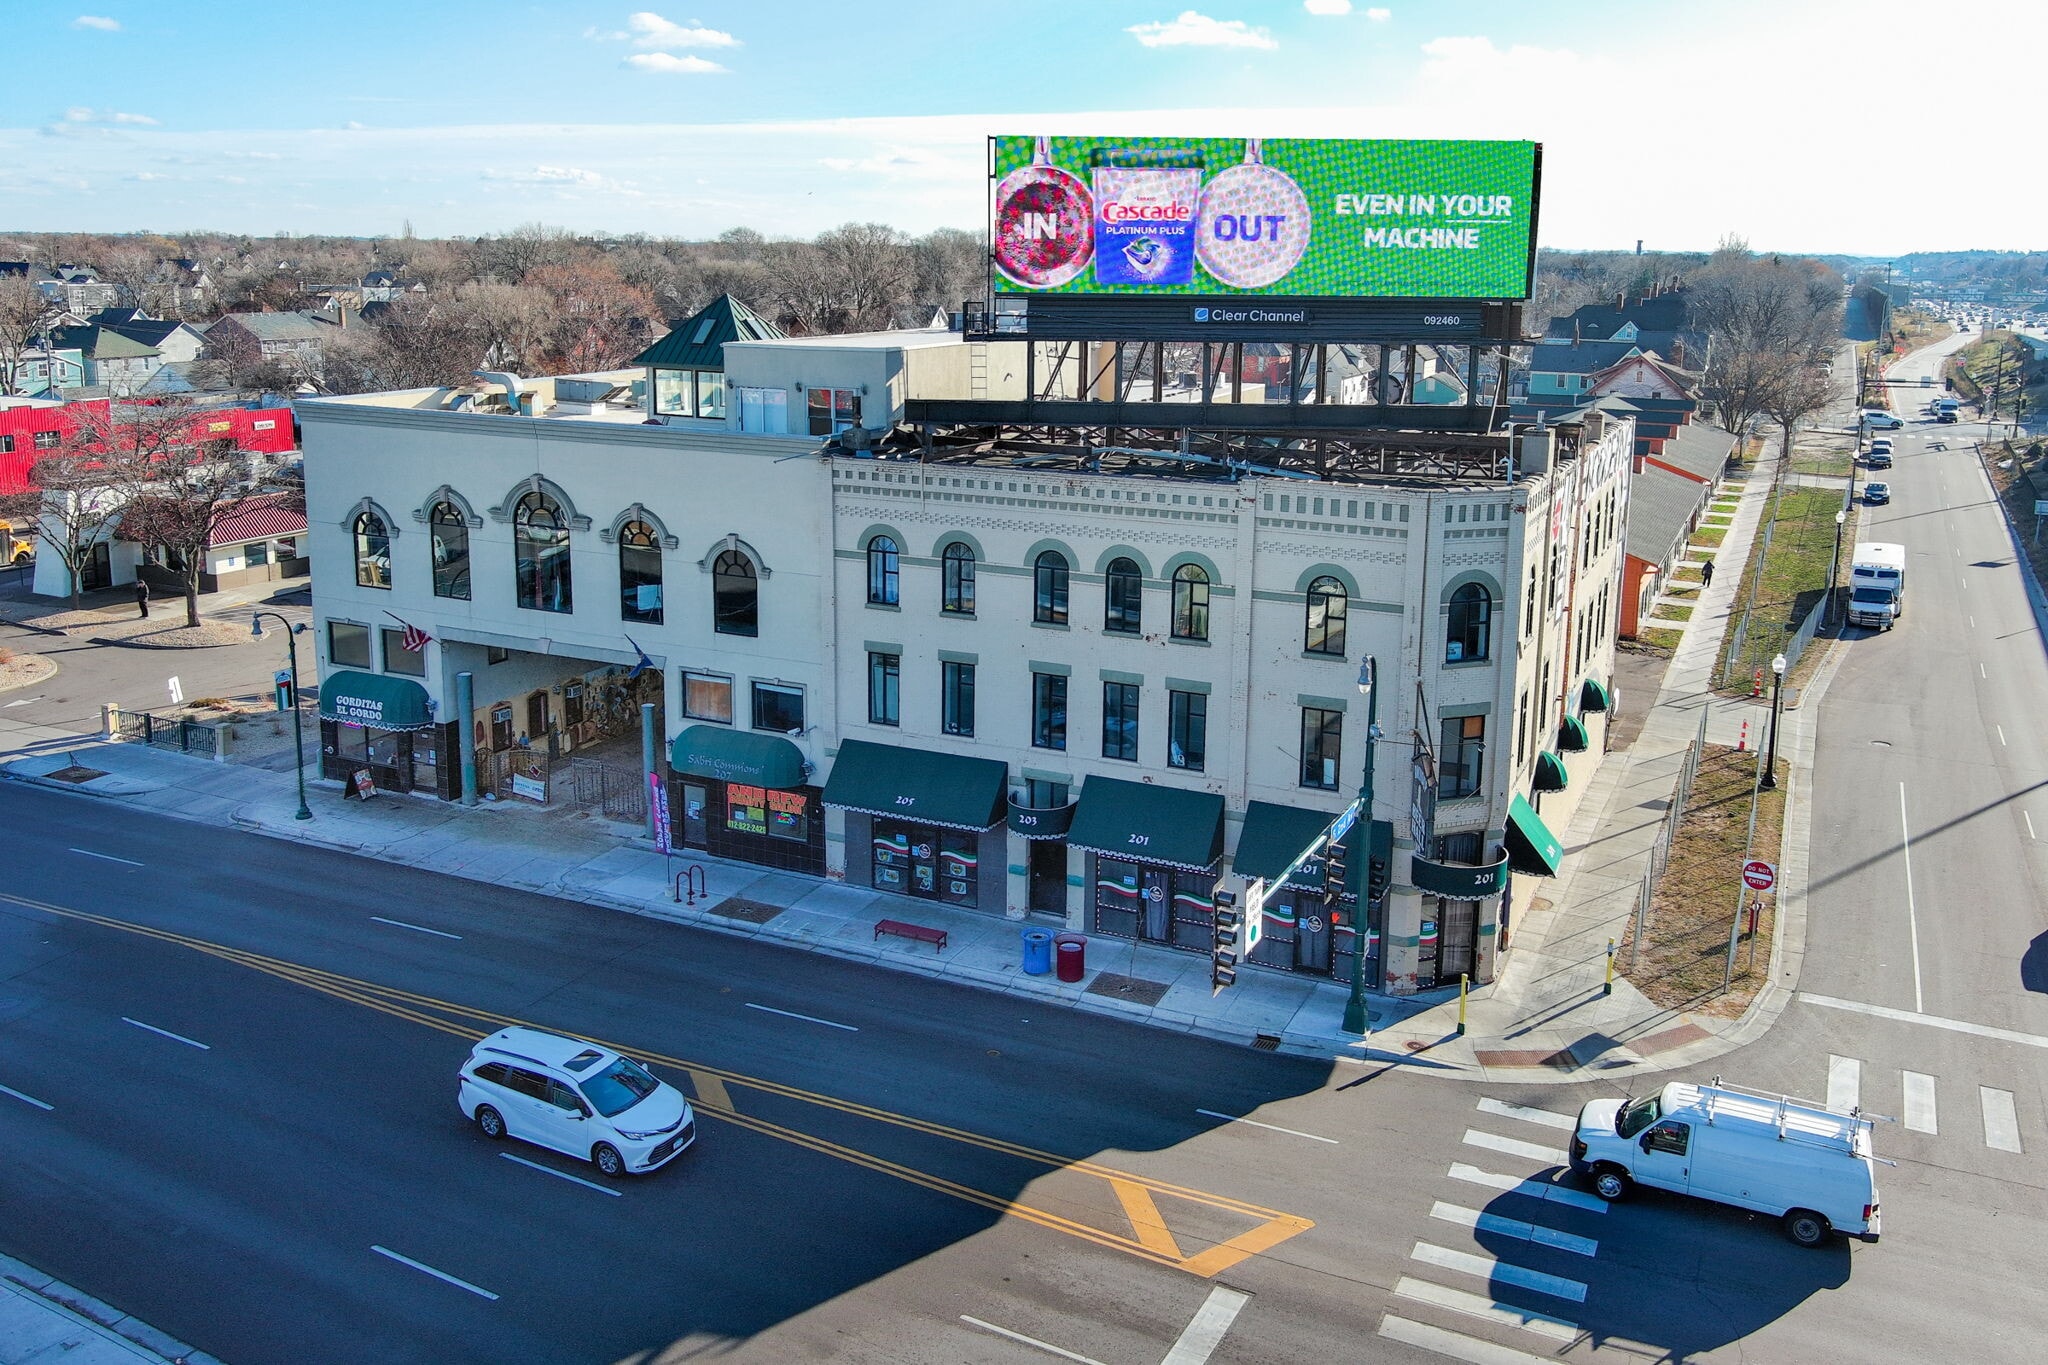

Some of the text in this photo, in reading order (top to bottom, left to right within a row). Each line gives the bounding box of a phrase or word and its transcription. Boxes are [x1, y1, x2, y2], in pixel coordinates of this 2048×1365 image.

[1102, 201, 1192, 224] Cascade
[1335, 194, 1513, 217] EVEN IN YOUR
[1023, 212, 1058, 240] IN
[1105, 226, 1186, 236] PLATINUM PLUS
[1213, 214, 1287, 242] OUT
[1364, 227, 1481, 250] MACHINE
[1211, 309, 1305, 323] Clear Channel
[1423, 315, 1460, 326] 092460
[336, 695, 383, 711] GORDITAS
[336, 705, 382, 720] EL GORDO
[714, 768, 732, 779] 207
[895, 795, 915, 806] 205
[1018, 814, 1038, 826] 203
[1128, 833, 1149, 845] 201
[1474, 872, 1495, 886] 201
[1748, 878, 1767, 886] ENTER
